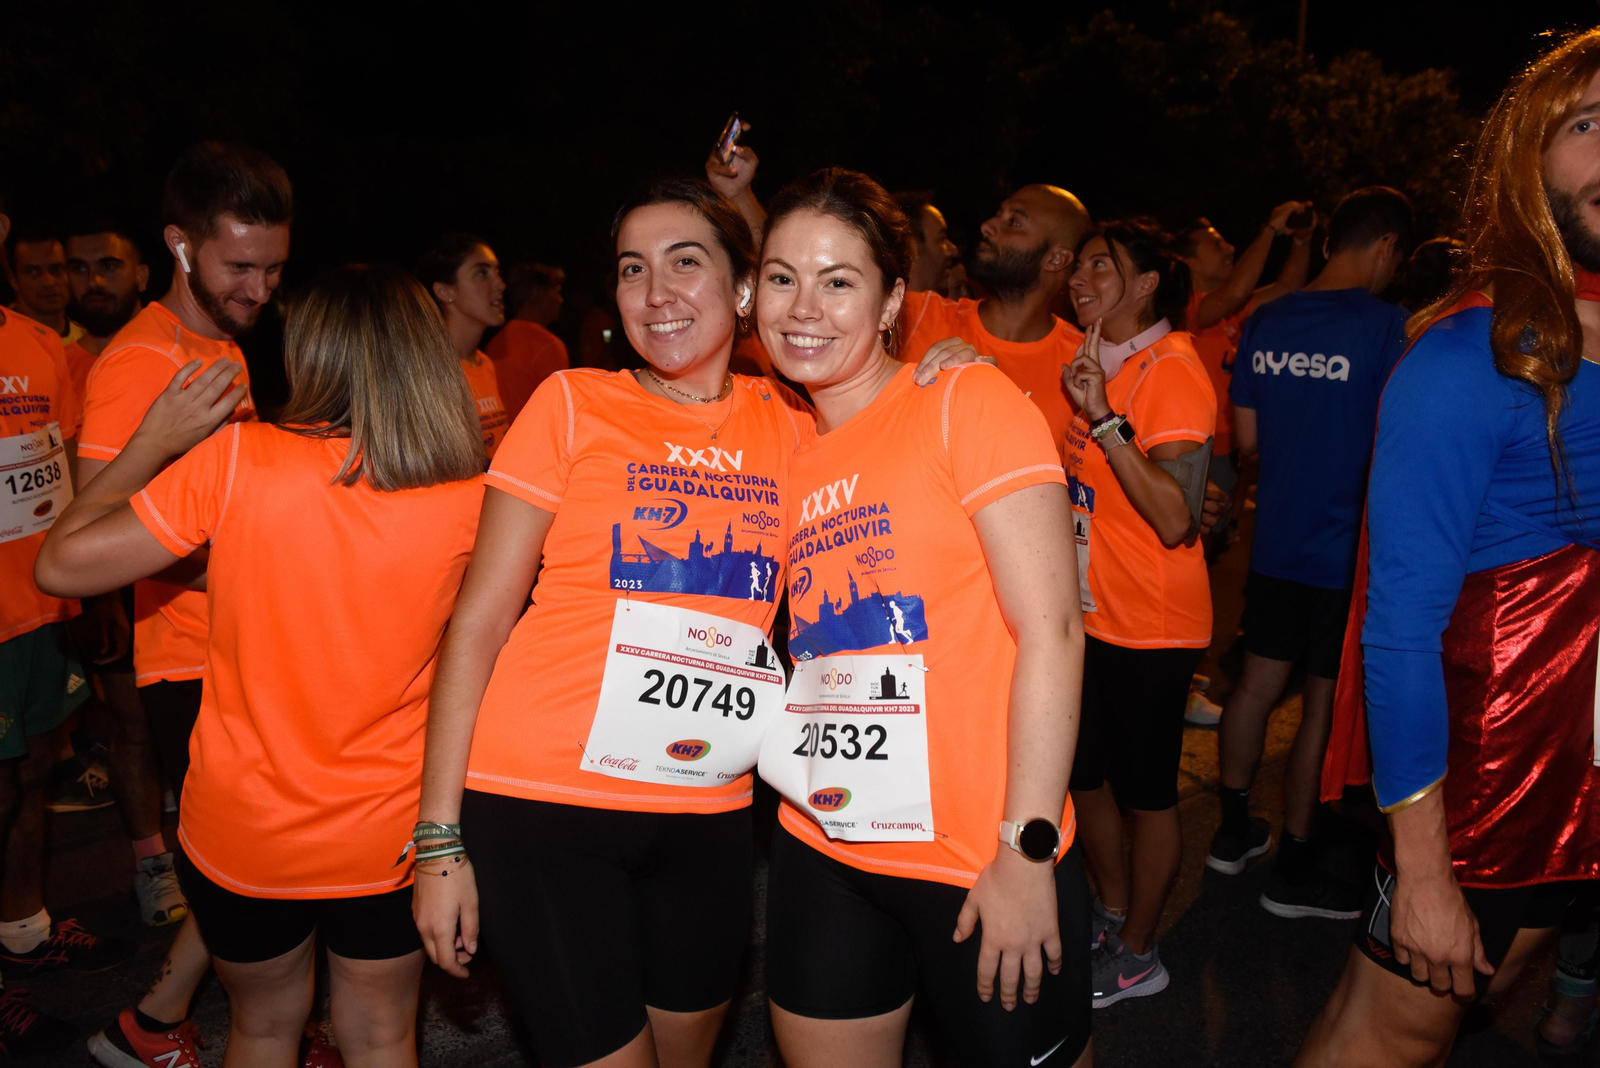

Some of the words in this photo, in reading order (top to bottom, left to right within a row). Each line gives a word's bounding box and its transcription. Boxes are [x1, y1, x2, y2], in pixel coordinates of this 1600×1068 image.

[1253, 350, 1350, 381] ayesa
[0, 404, 50, 416] LQUIVIR
[663, 441, 743, 472] XXXV
[5, 461, 61, 495] 12638
[626, 475, 636, 491] DEL
[627, 462, 700, 479] CARRERA
[704, 471, 779, 489] NOCTURNA
[638, 477, 780, 507] GUADALQUIVIR
[798, 473, 859, 526] XXXV
[789, 524, 817, 550] ARRERA
[821, 502, 890, 532] NOCTURNA
[789, 518, 892, 568] GUADALQUIVIR
[614, 579, 643, 590] 2023
[620, 645, 640, 654] XXXV
[641, 649, 670, 661] CARRERA
[671, 655, 705, 667] NOCTURNA
[706, 661, 715, 669] DEL
[716, 663, 757, 677] GUADALQUIVIR
[767, 674, 779, 683] 2023
[638, 669, 756, 720] 20749
[838, 705, 883, 713] GUADALQUIVIR
[793, 722, 888, 760] 20532
[871, 821, 923, 831] Cruzcampo
